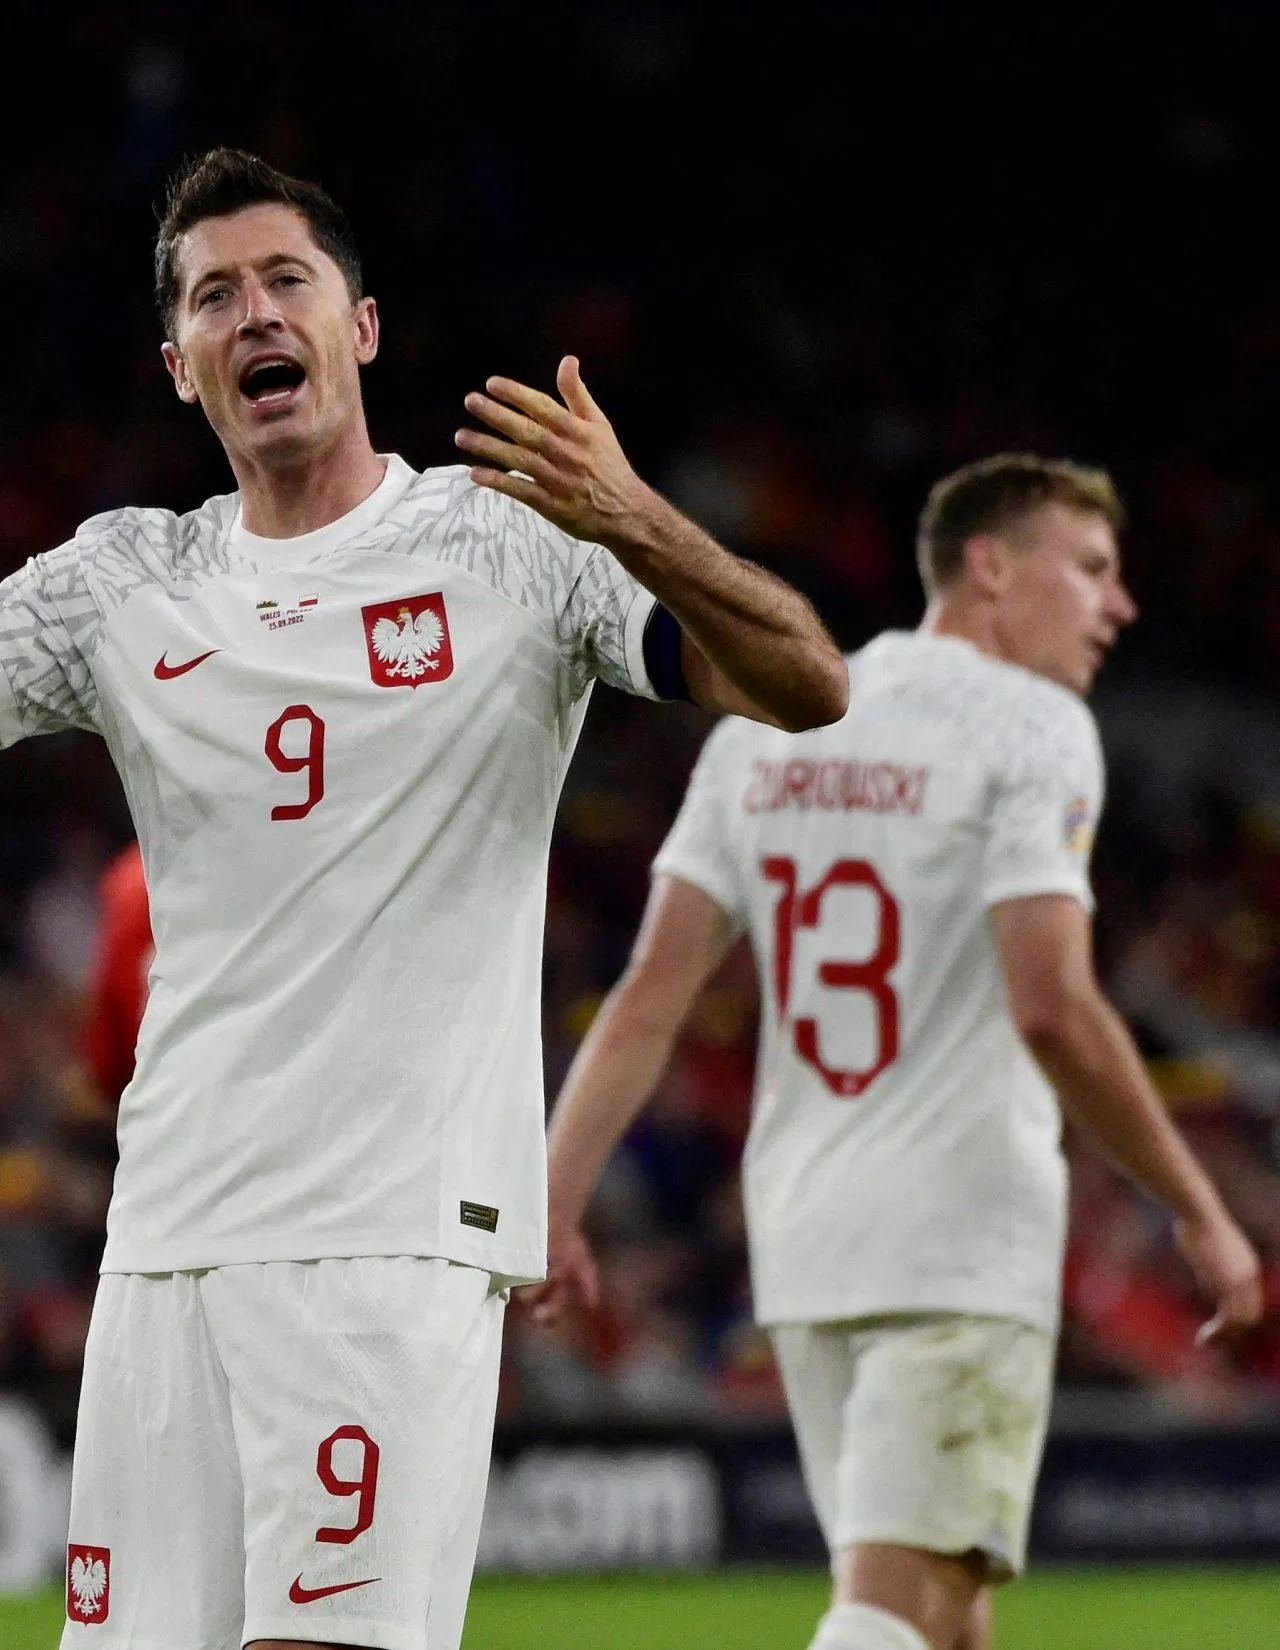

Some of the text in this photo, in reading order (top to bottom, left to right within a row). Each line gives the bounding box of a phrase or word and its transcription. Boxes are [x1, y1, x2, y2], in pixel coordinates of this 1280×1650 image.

[260, 610, 281, 622] WALES
[268, 614, 304, 631] 25.09.2022
[265, 704, 325, 820] 9
[761, 856, 900, 1098] 13
[316, 1425, 380, 1544] 9
